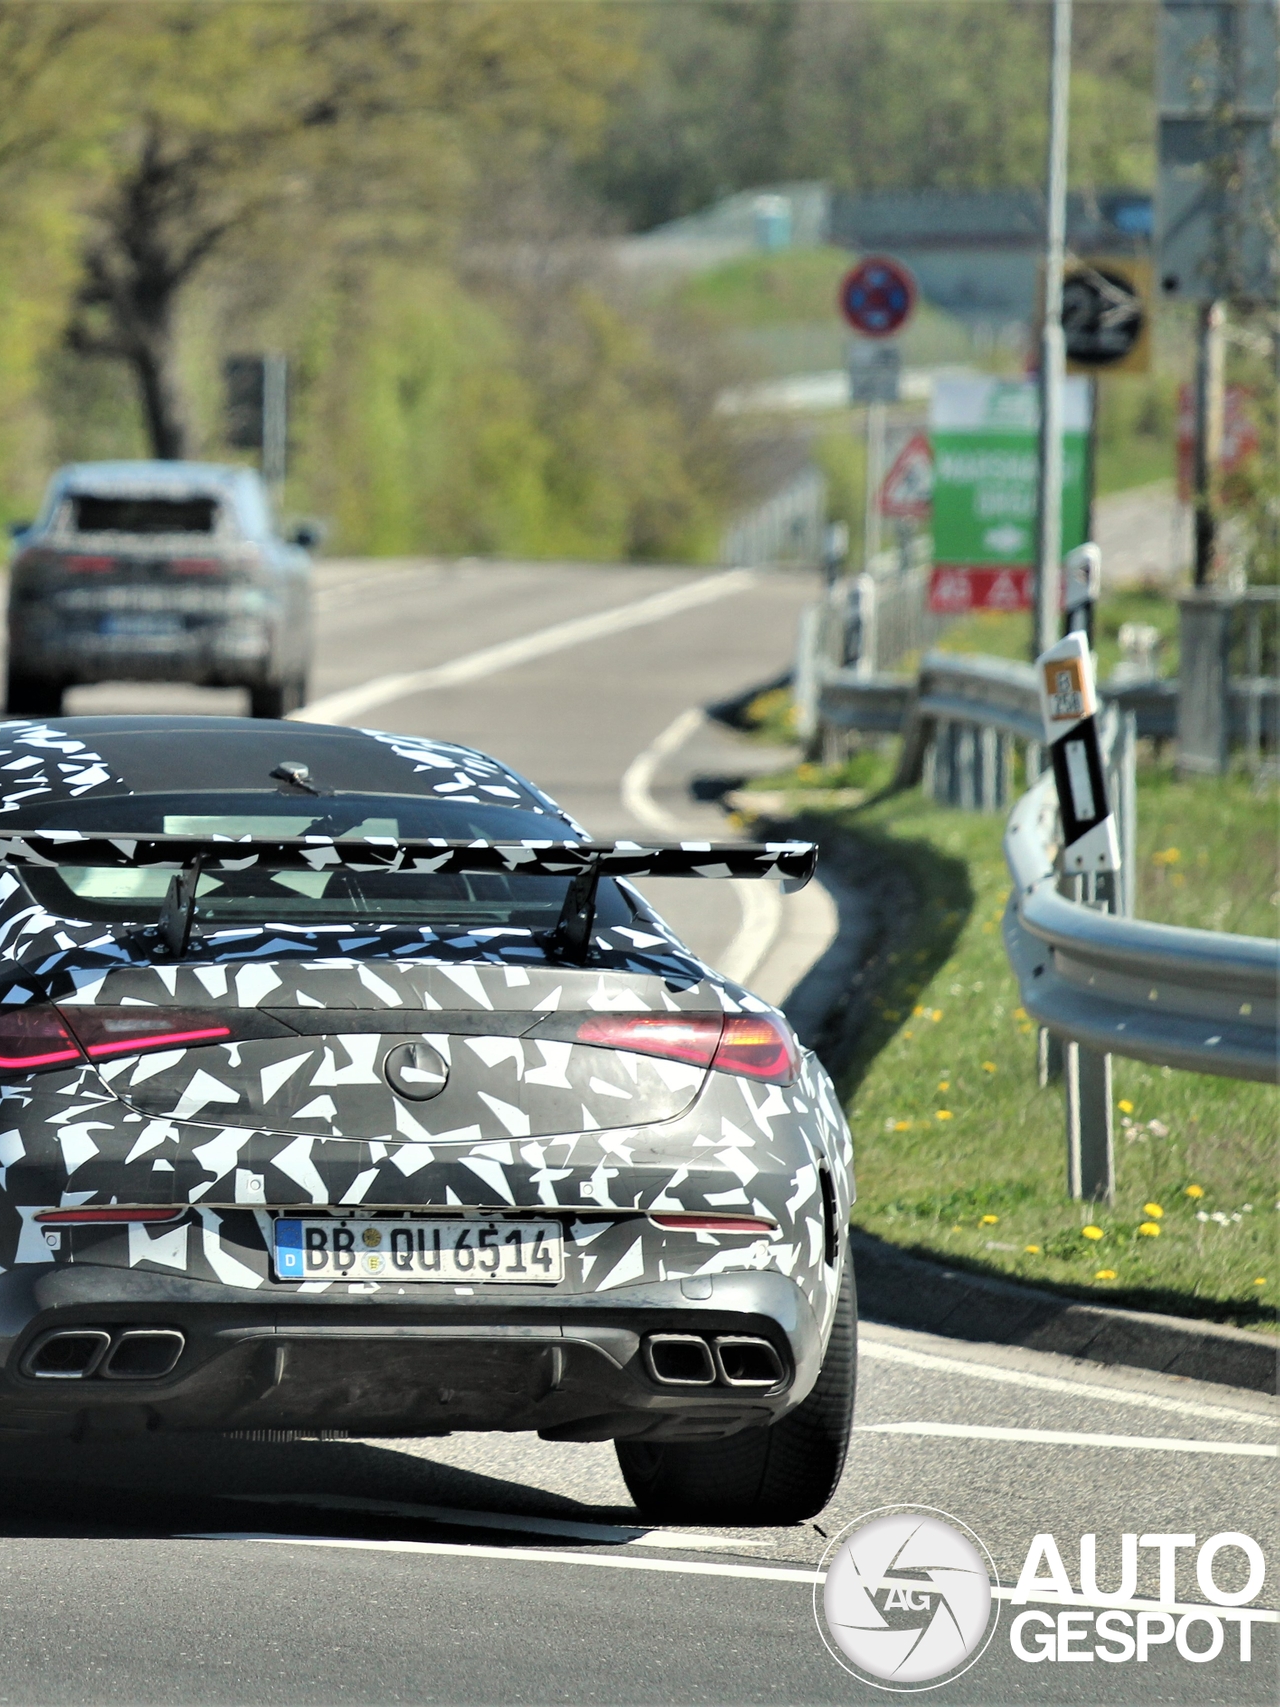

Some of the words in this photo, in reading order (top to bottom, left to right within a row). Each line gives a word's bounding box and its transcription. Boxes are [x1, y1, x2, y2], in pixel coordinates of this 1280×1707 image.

[285, 1254, 296, 1267] D
[305, 1227, 356, 1271] BB
[390, 1228, 441, 1271] QU
[454, 1229, 552, 1272] 6514
